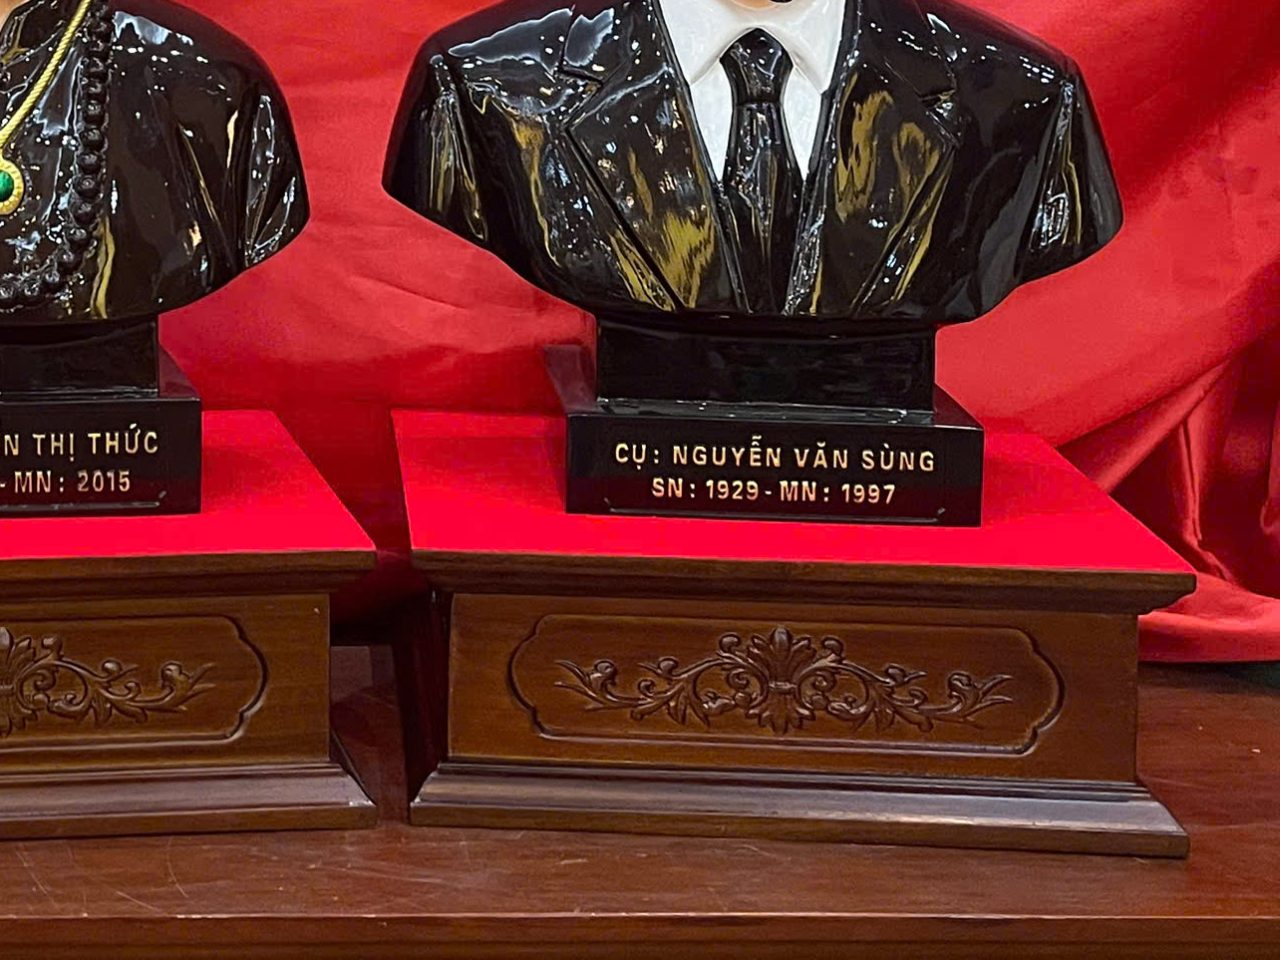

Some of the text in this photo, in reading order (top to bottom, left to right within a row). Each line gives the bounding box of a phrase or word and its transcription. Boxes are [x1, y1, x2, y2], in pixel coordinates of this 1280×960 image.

[32, 433, 75, 462] THỊ
[87, 423, 158, 455] THỨC
[673, 435, 781, 467] NGUYỄN
[793, 442, 848, 469] VĂN
[861, 443, 935, 472] SÙNG
[77, 469, 131, 492] 2015
[706, 479, 759, 501] 1929
[841, 483, 896, 505] 1997
